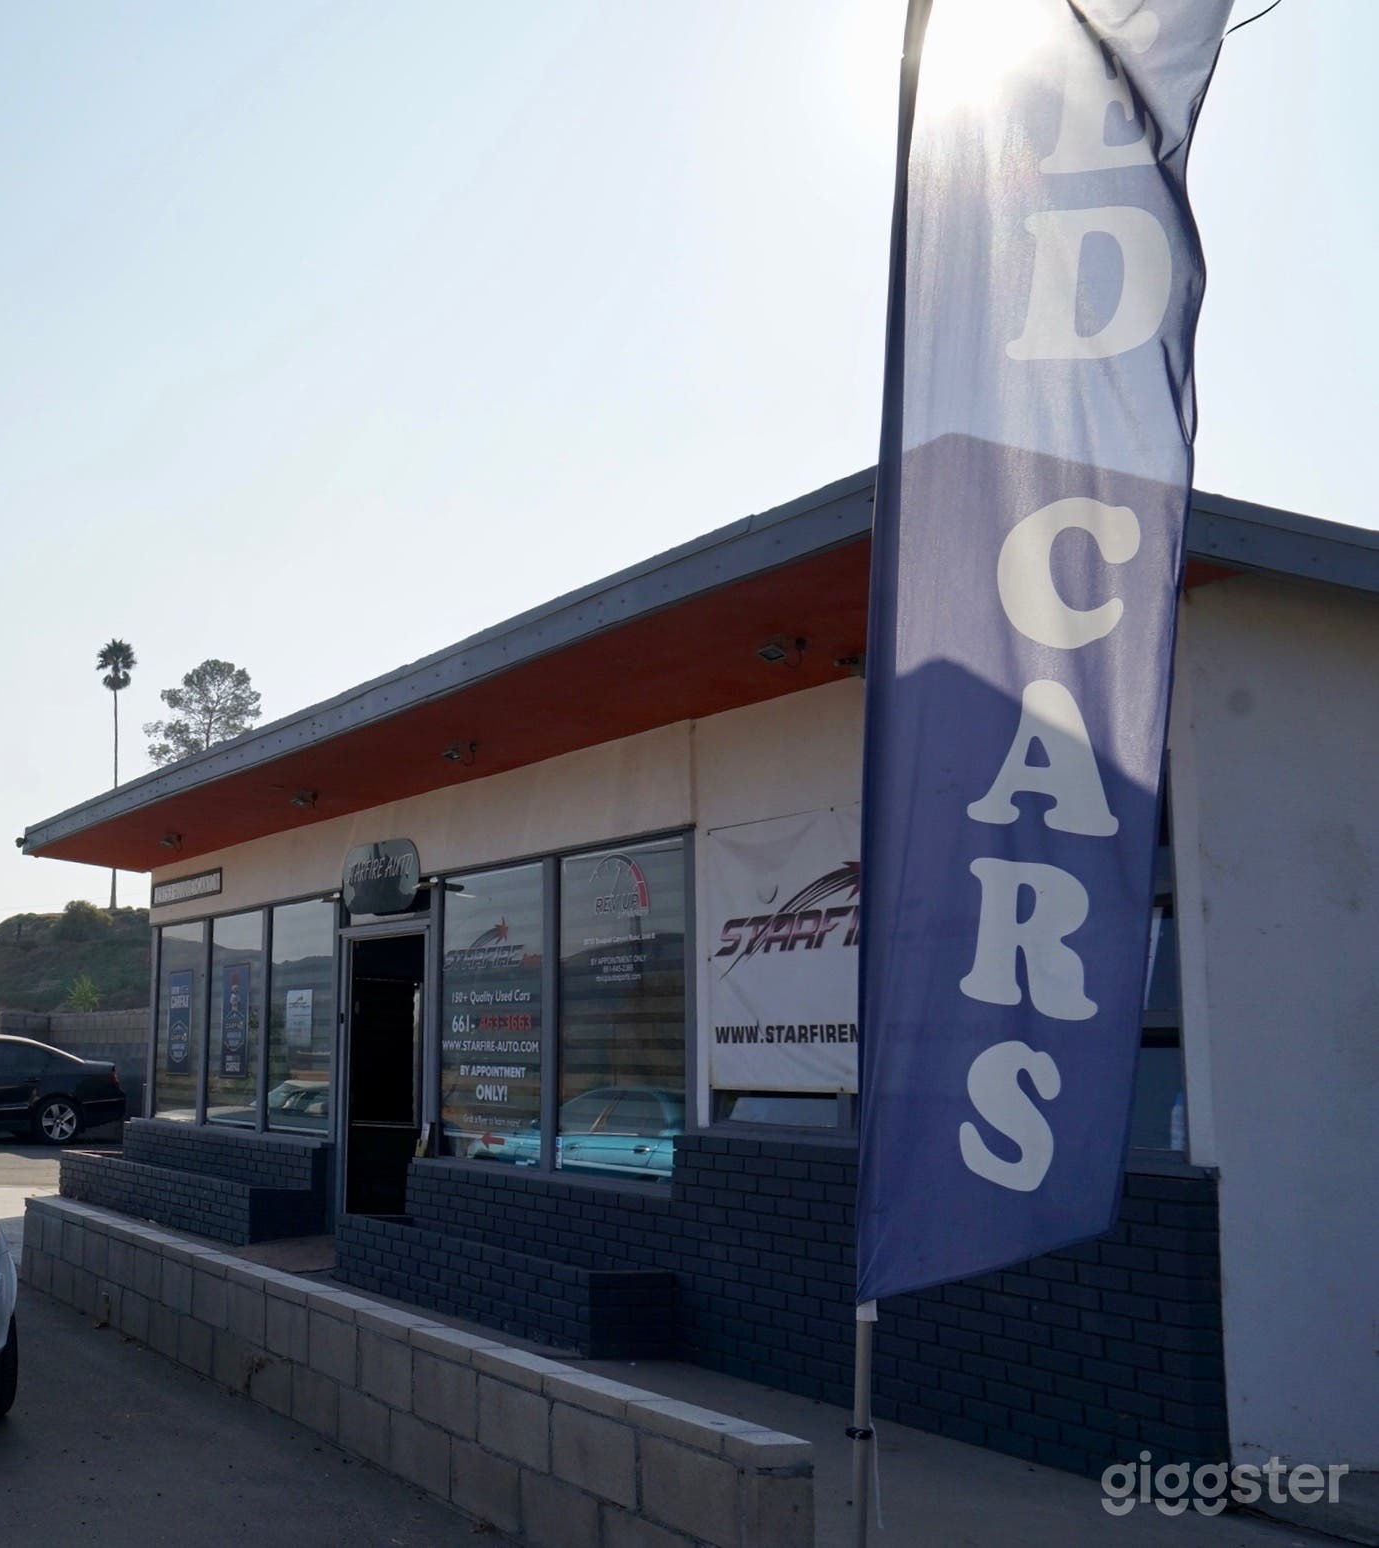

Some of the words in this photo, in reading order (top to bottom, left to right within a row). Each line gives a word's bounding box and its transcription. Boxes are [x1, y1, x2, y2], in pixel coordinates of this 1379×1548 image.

[959, 496, 1141, 1192] CARS
[713, 905, 860, 957] STARFI
[470, 991, 494, 1005] Quality
[495, 989, 513, 1002] Used
[514, 988, 531, 1002] Cars
[459, 1064, 470, 1076] BY
[470, 1065, 527, 1079] APPOINTMENT
[475, 1084, 508, 1102] ONLY!
